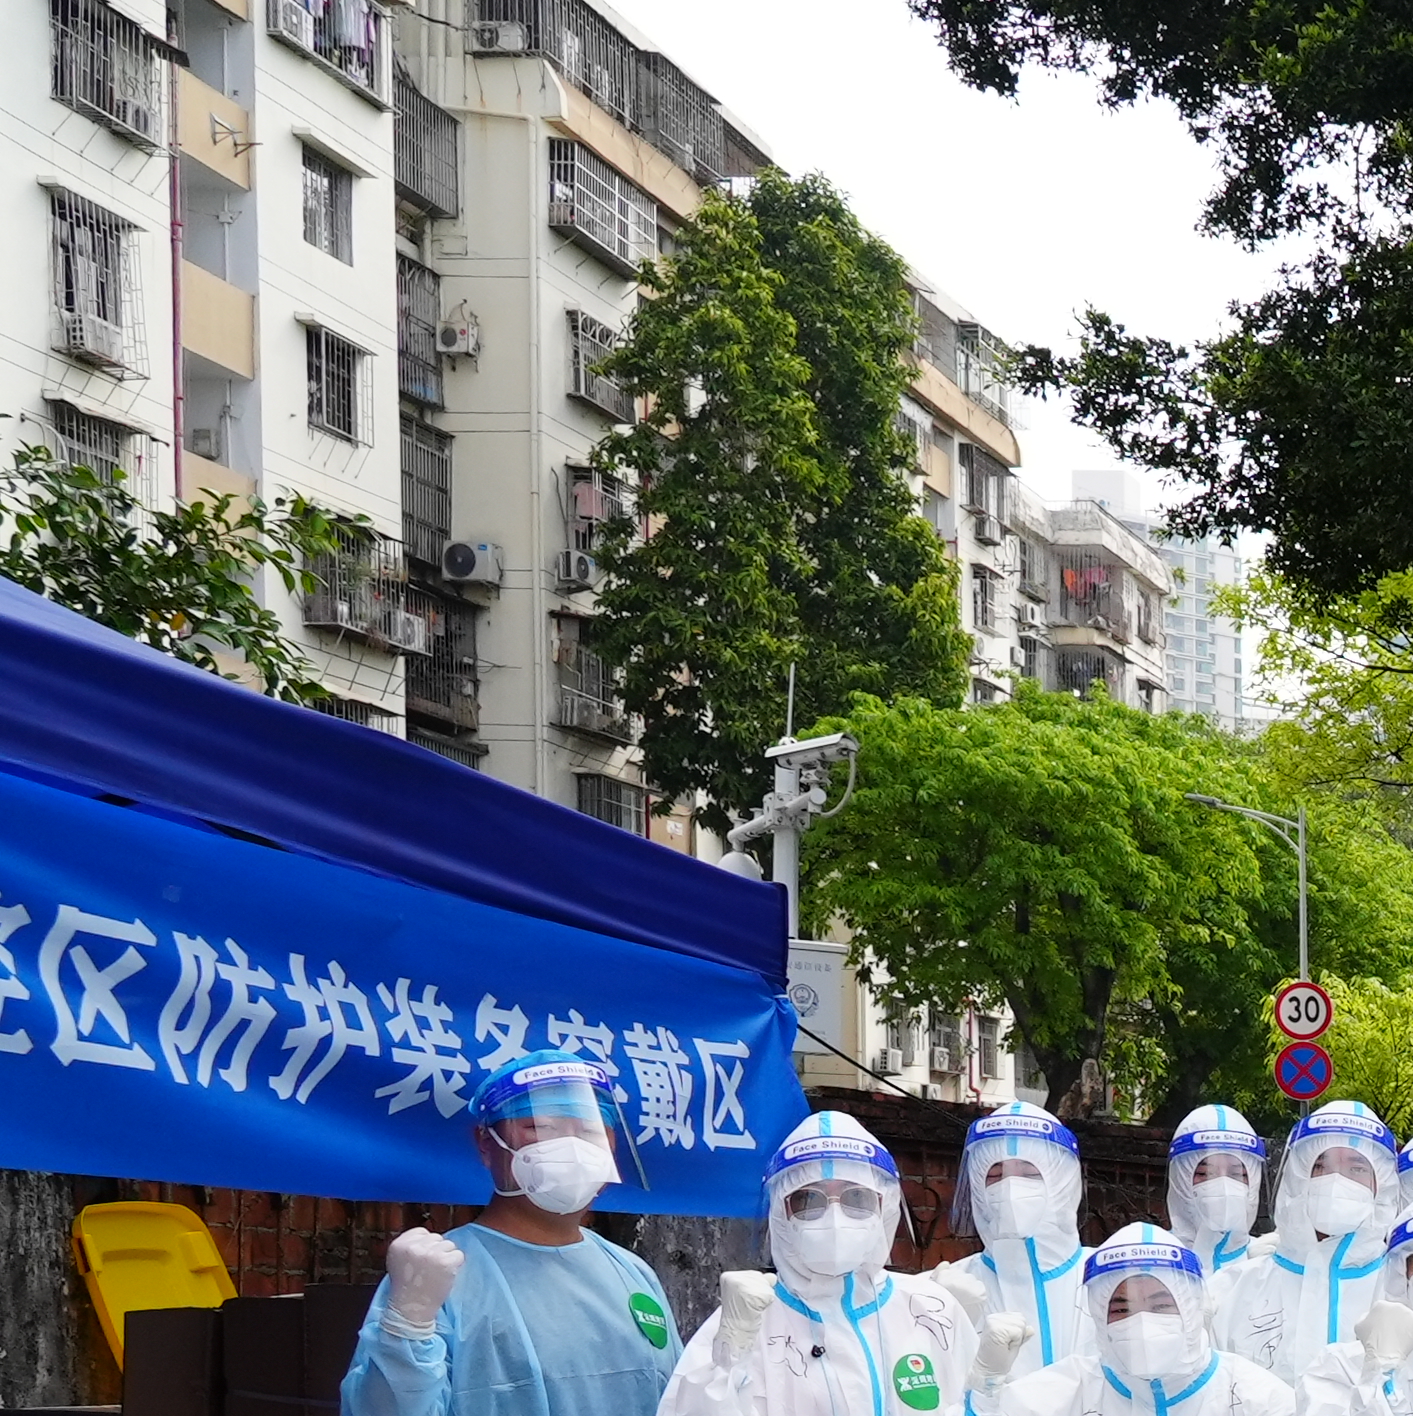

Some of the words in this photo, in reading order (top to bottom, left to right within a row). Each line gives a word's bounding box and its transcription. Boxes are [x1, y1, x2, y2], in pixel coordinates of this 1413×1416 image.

[1288, 996, 1320, 1023] 30
[524, 1068, 553, 1080] Face
[557, 1065, 594, 1077] Shield
[982, 1119, 1002, 1130] Face
[1005, 1118, 1039, 1129] Shield
[1315, 1116, 1342, 1126] Face
[1345, 1118, 1373, 1131] Shield
[1200, 1133, 1221, 1142] Face
[1224, 1134, 1249, 1145] Shield
[793, 1142, 817, 1154] Face
[821, 1141, 860, 1151] Shield
[1103, 1250, 1127, 1261] Face
[1131, 1247, 1167, 1257] Shield
